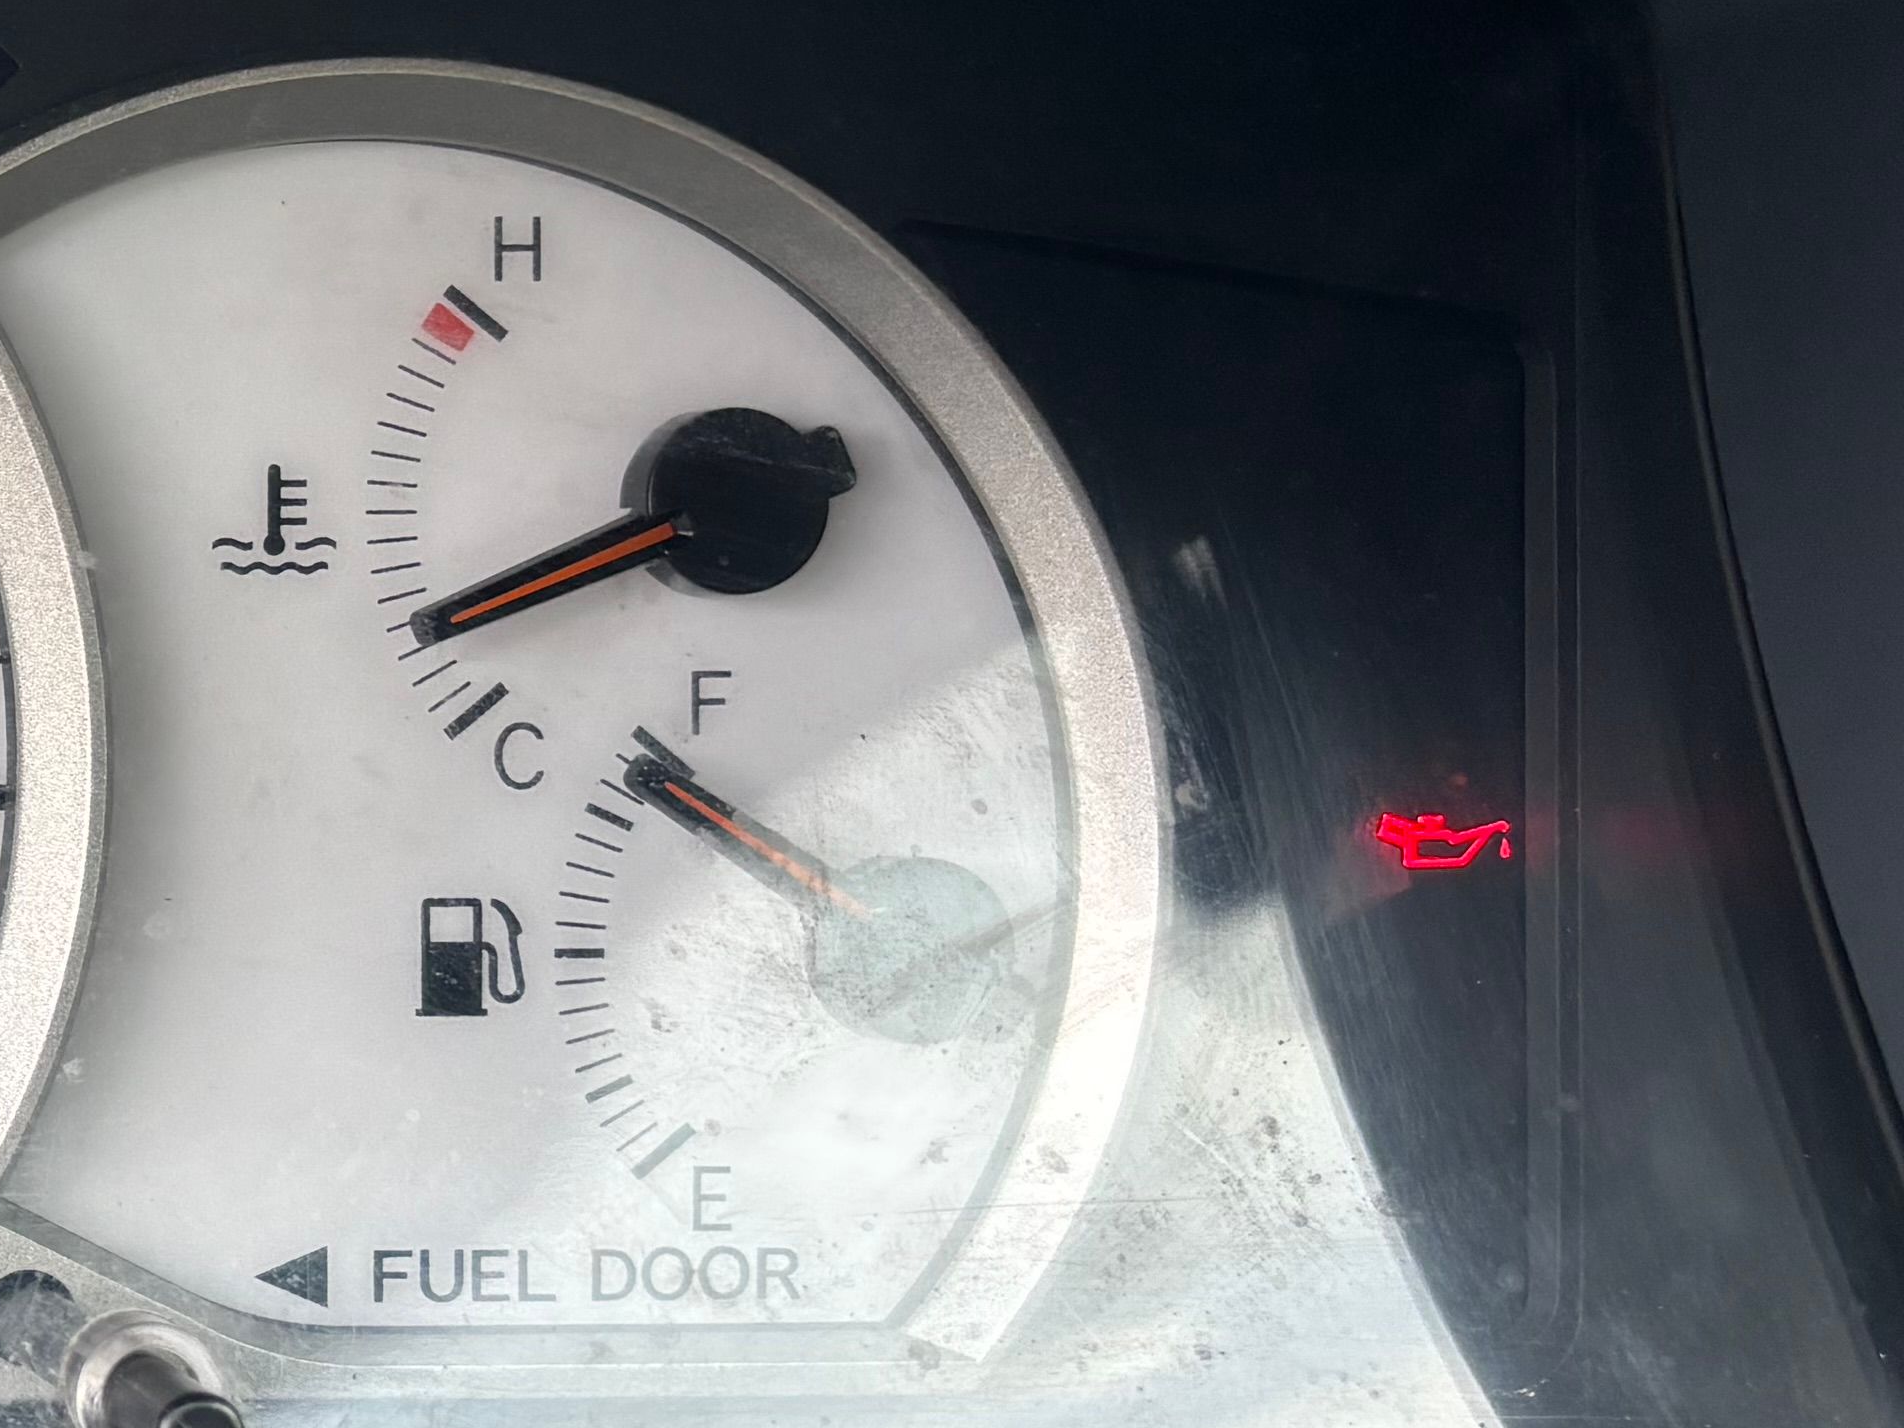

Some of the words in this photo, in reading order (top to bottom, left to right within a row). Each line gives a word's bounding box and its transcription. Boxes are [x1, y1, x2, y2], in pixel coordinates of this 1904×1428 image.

[493, 215, 541, 282] H
[691, 669, 732, 736] F
[494, 722, 544, 789] C
[693, 1166, 731, 1232] E
[373, 1248, 556, 1303] FUEL
[593, 1246, 800, 1302] DOOR
